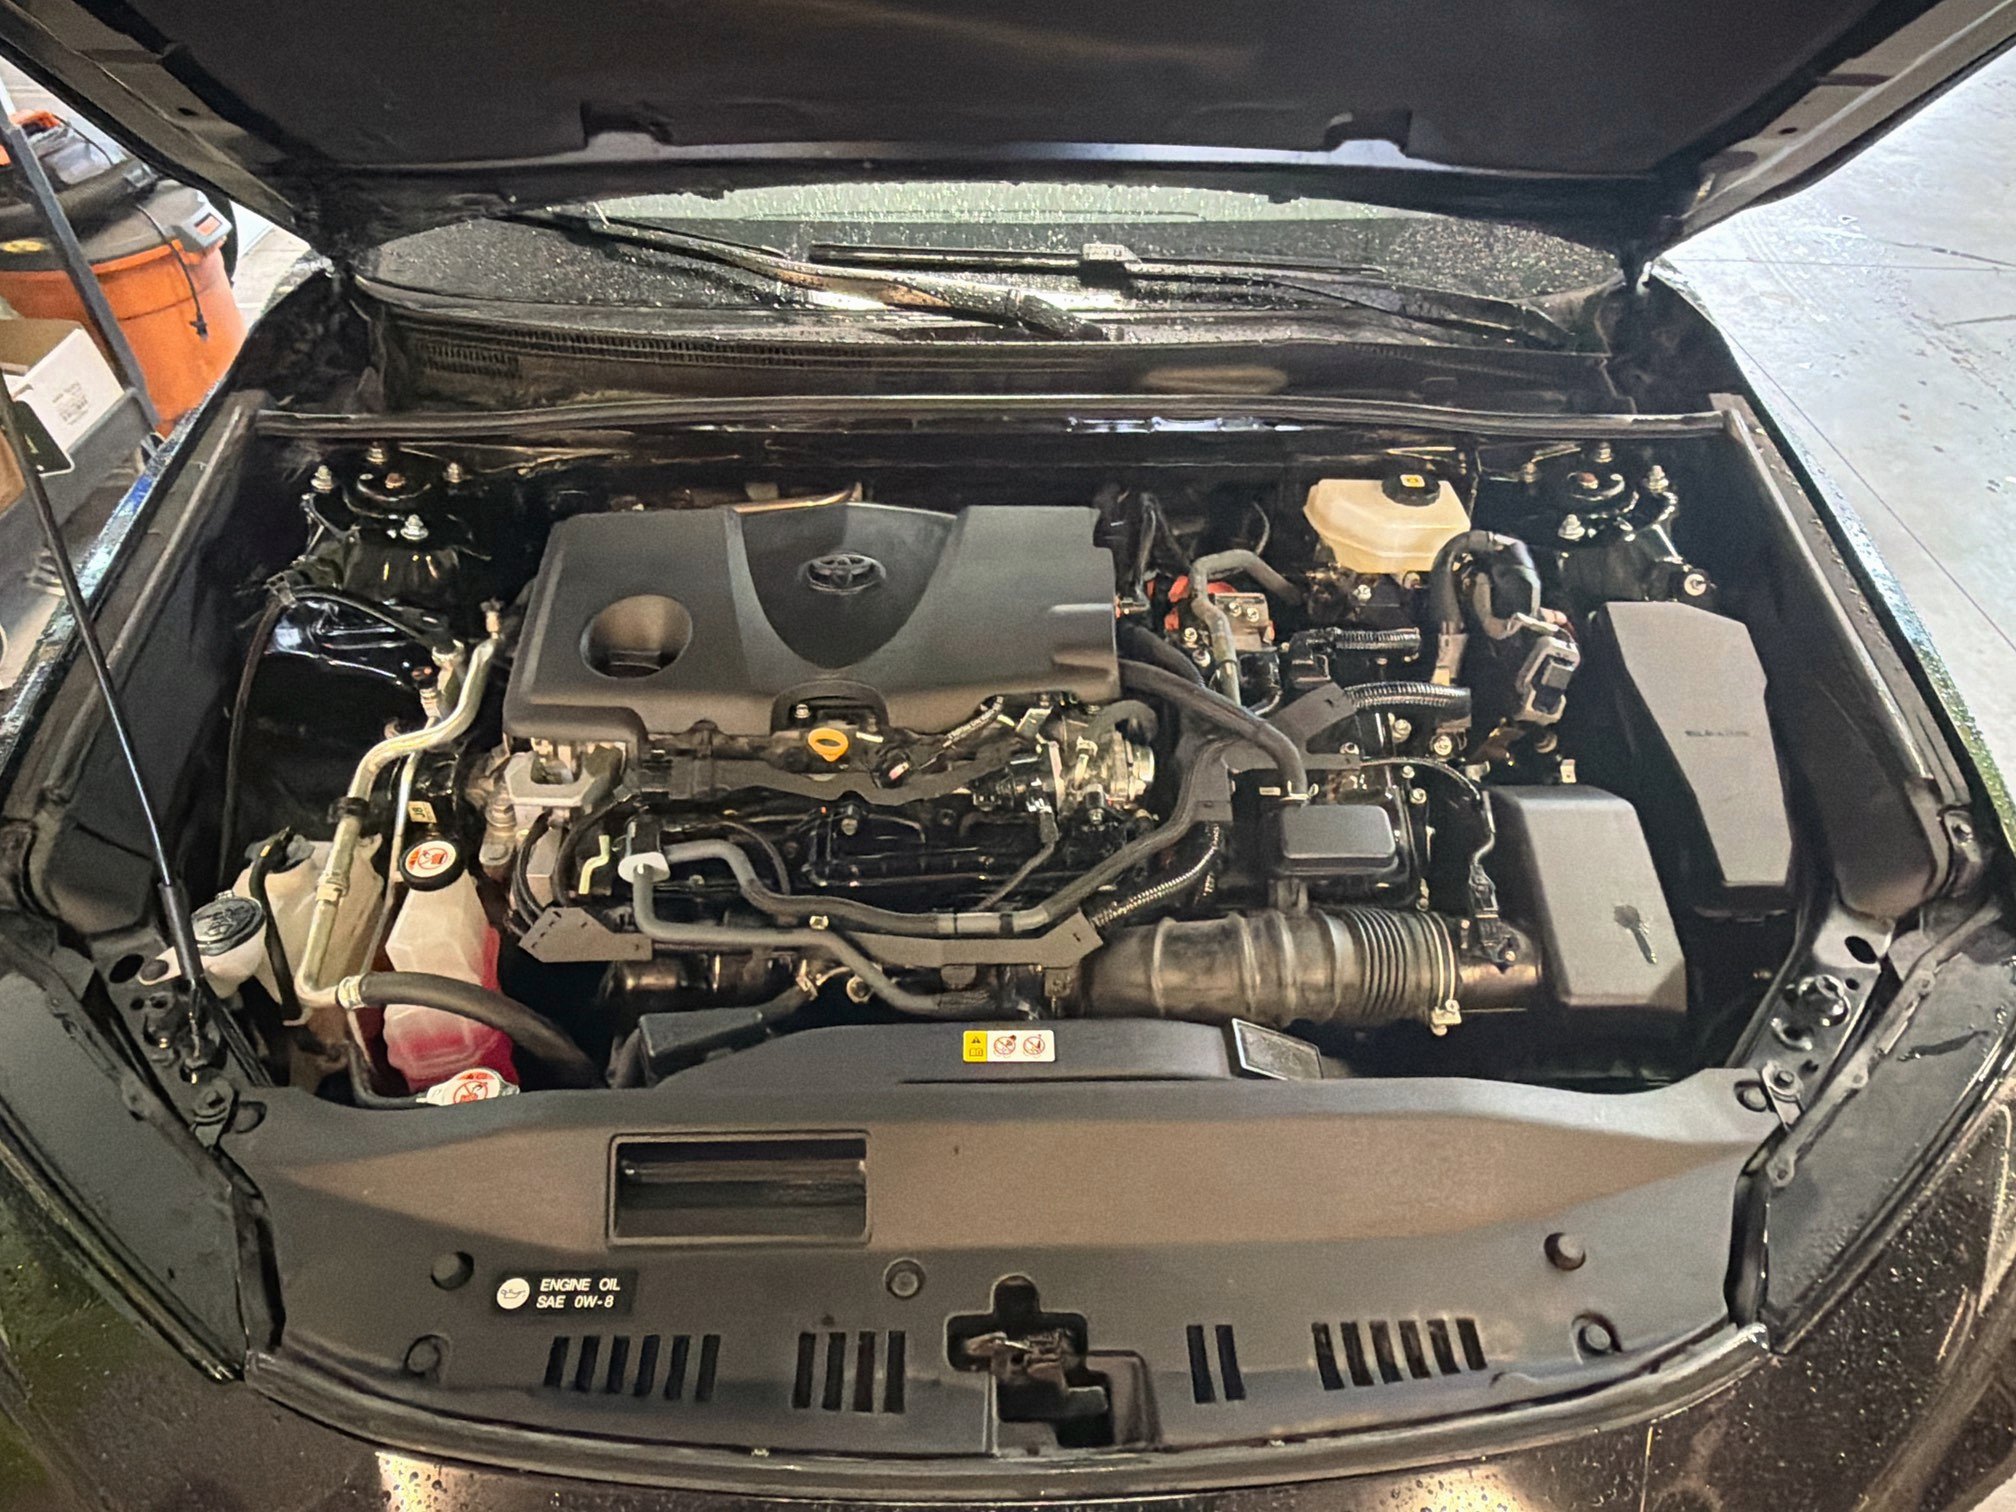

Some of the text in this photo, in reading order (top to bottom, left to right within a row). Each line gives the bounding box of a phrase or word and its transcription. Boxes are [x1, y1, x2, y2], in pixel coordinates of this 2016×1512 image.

[540, 1277, 621, 1292] ENGINE OIL
[536, 1294, 615, 1309] SAE 0W-8
